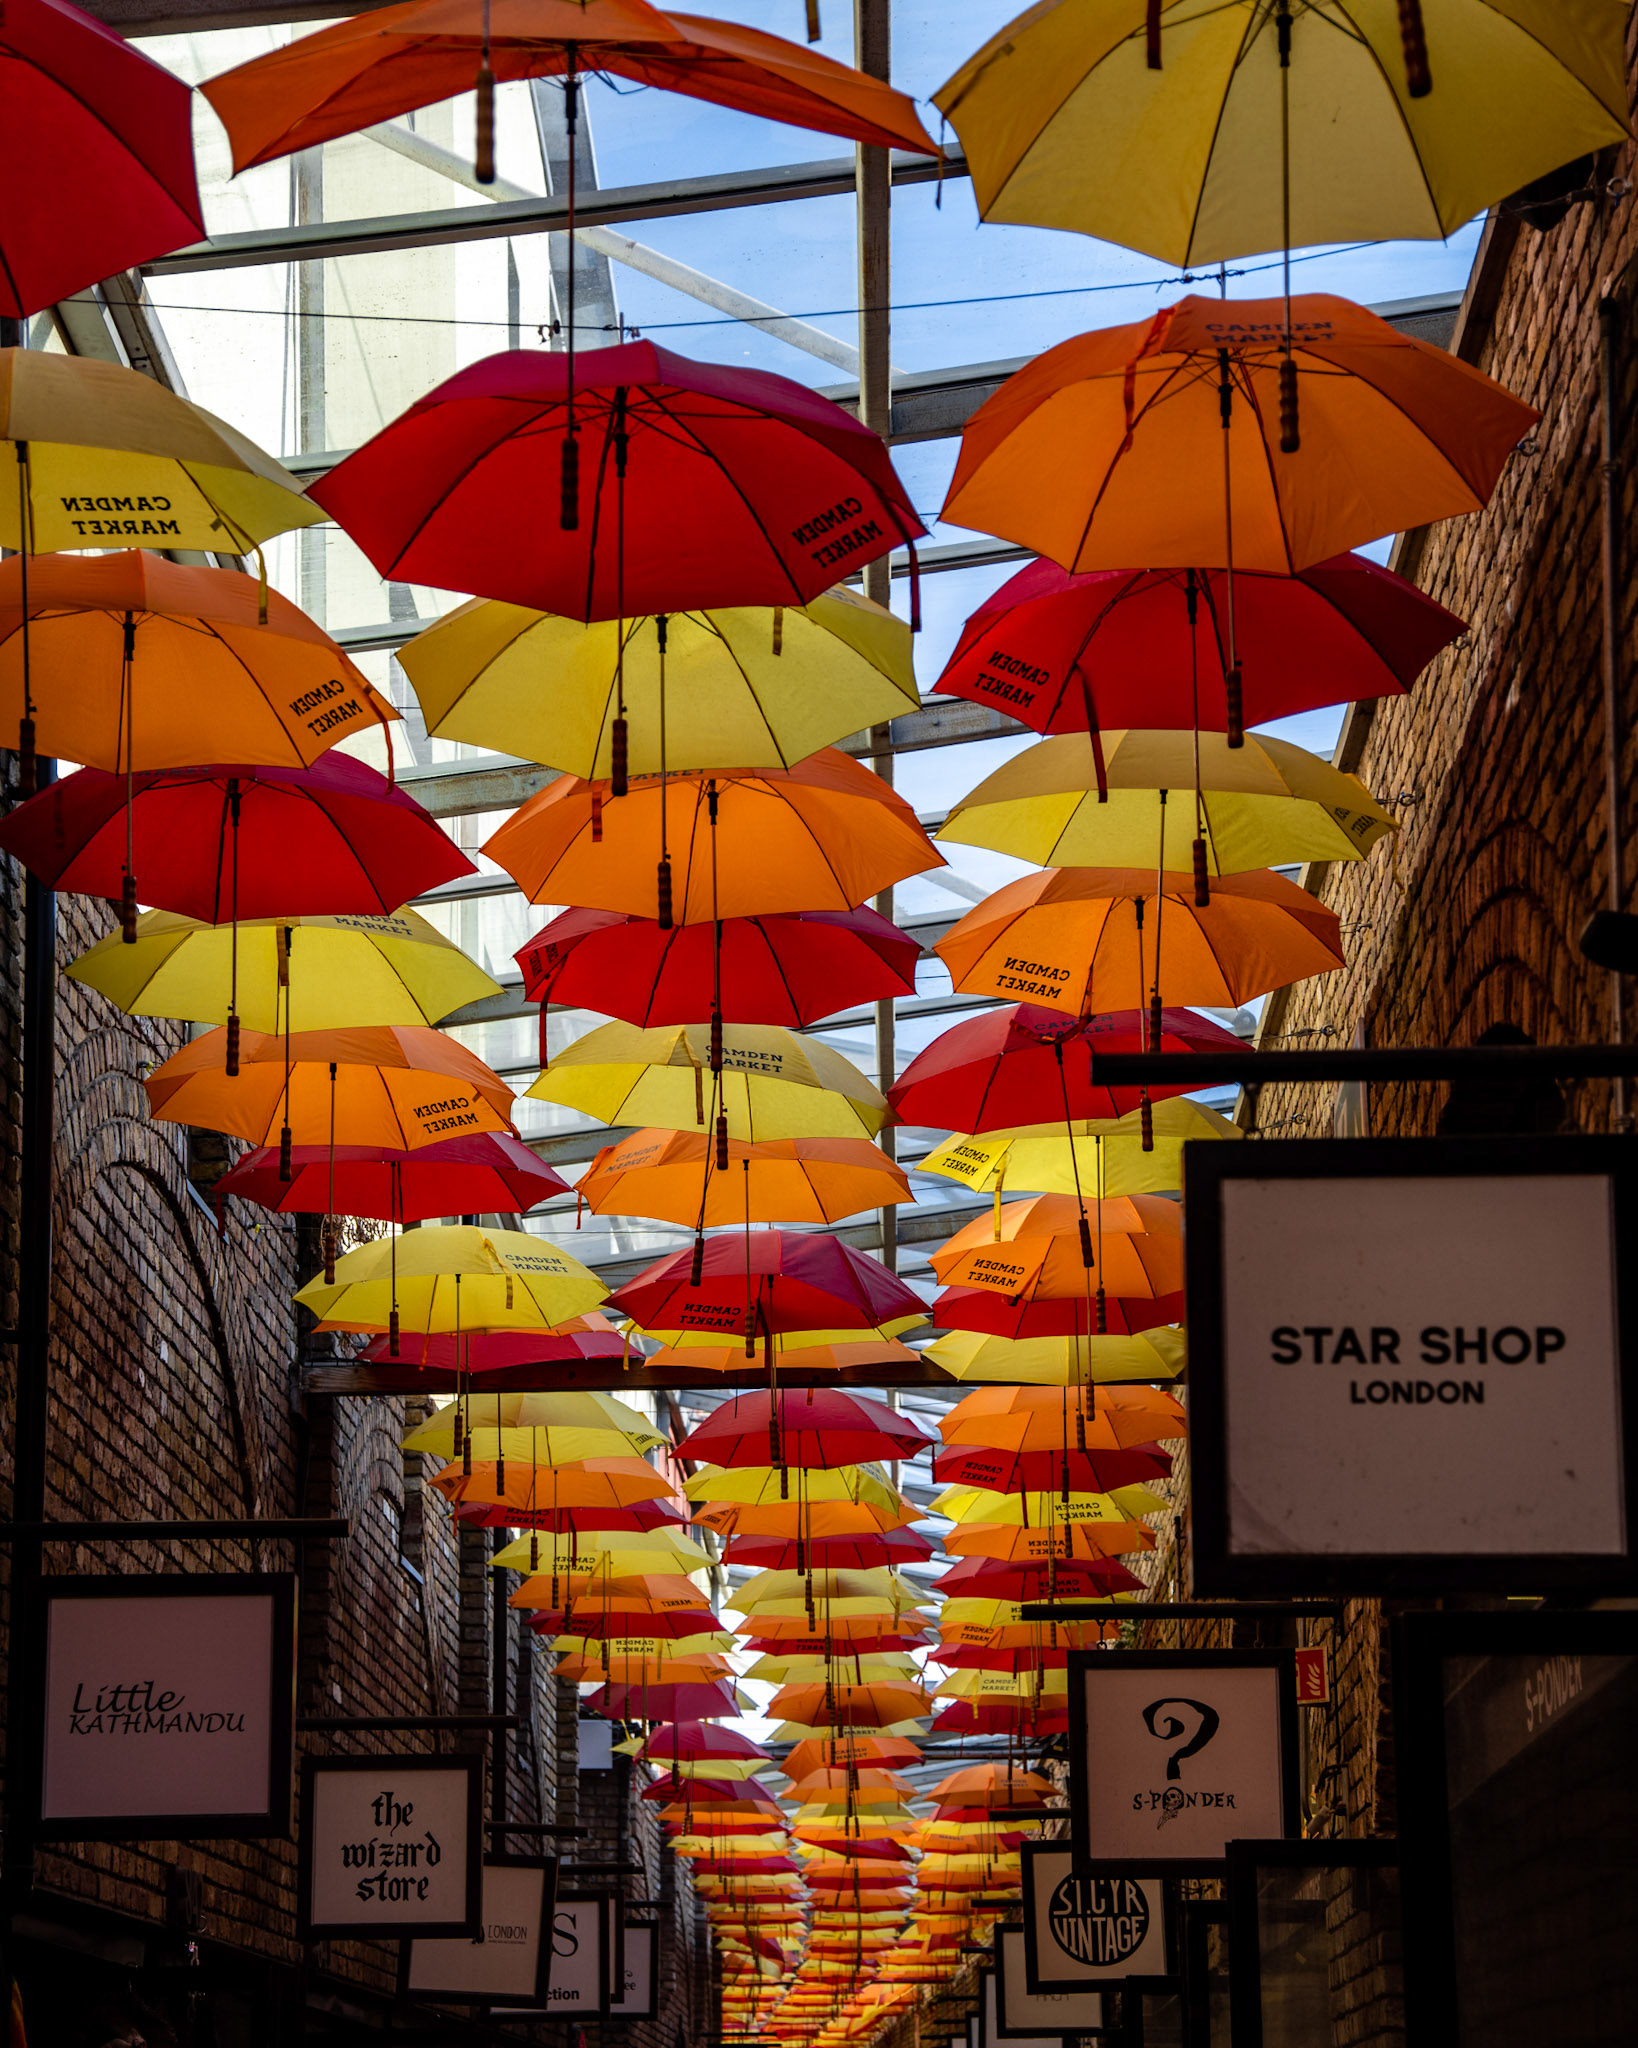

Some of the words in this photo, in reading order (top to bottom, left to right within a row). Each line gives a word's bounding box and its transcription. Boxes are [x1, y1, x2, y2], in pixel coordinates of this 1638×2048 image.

[334, 916, 413, 935] MARKET
[505, 1254, 562, 1265] CAMDEN
[512, 1263, 568, 1273] MARKET
[1271, 1326, 1400, 1364] STAR
[1420, 1326, 1566, 1364] SHOP
[1350, 1380, 1484, 1404] LONDON
[73, 1681, 186, 1714] Little
[69, 1712, 245, 1735] KATHMANDU
[371, 1792, 413, 1836] the
[341, 1831, 441, 1868] wizard
[356, 1870, 429, 1901] store
[488, 1925, 528, 1939] LONDON
[1053, 1915, 1146, 1962] VINTAGE
